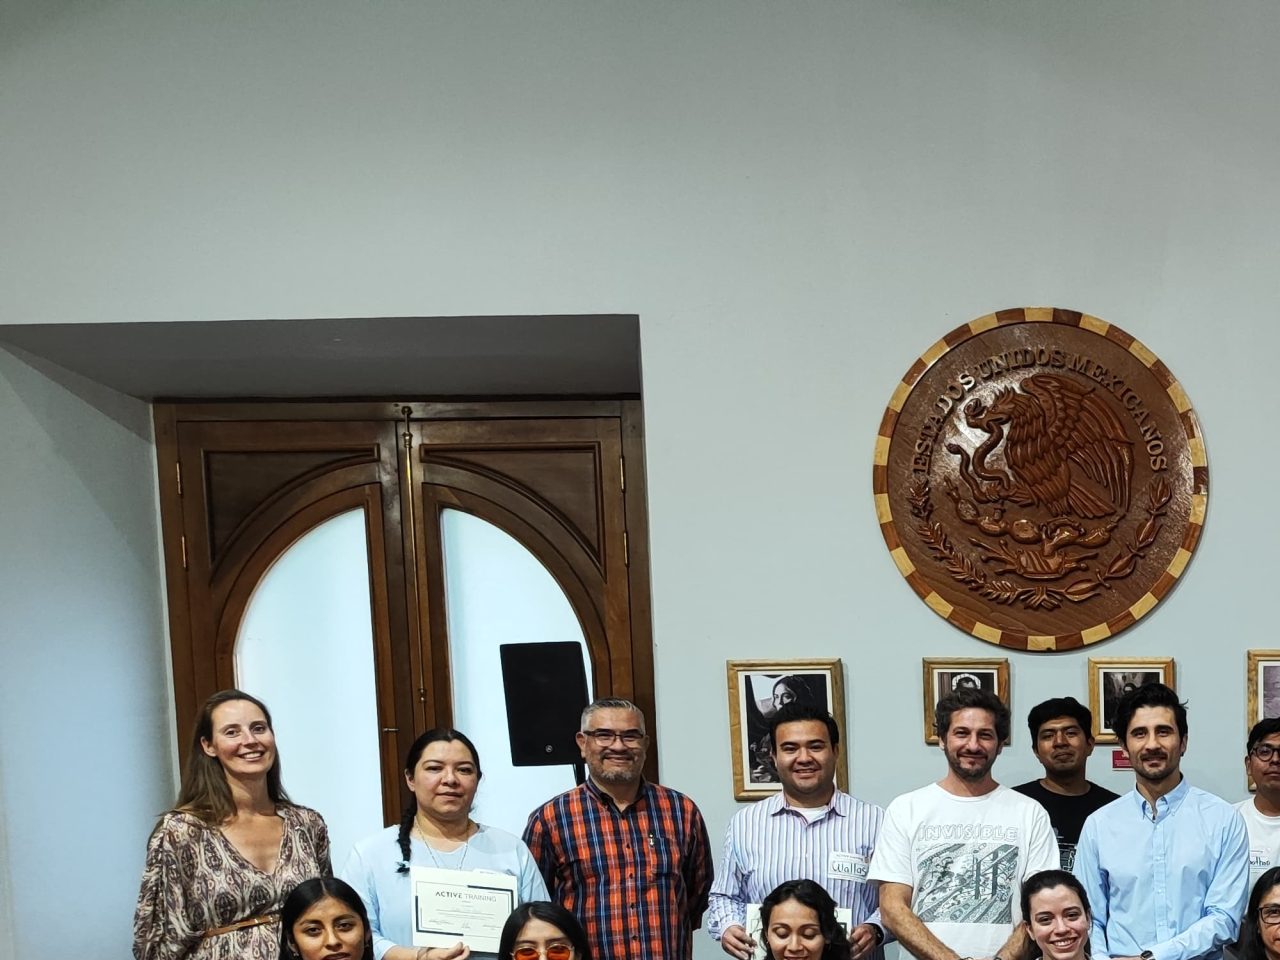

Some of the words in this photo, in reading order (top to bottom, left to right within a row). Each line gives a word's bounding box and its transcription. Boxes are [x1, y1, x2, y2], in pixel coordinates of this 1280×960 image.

[914, 372, 976, 475] ESTADOS
[978, 348, 1069, 378] UNIDOS
[1069, 354, 1167, 473] MEXICANOS
[918, 823, 1019, 843] INVISIBLE
[435, 890, 462, 899] ACTIVE
[464, 893, 497, 902] TRAINING
